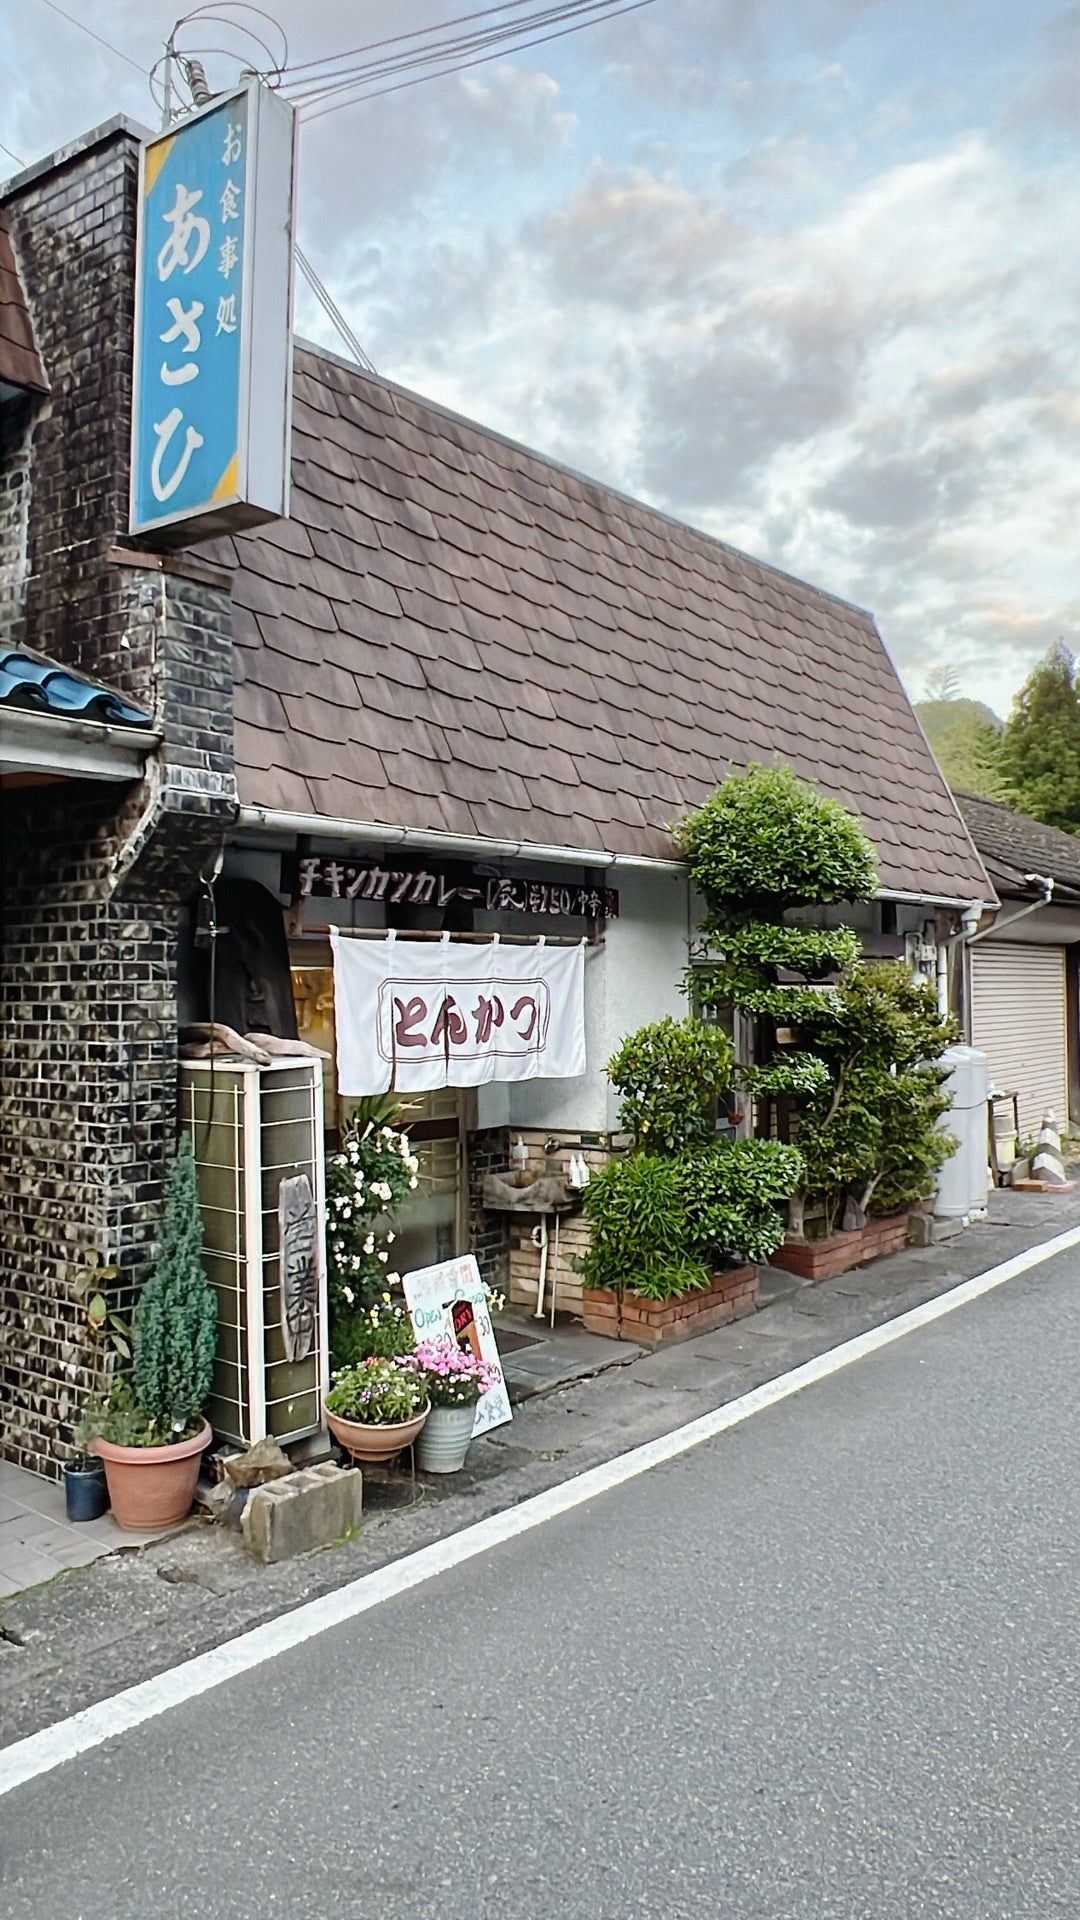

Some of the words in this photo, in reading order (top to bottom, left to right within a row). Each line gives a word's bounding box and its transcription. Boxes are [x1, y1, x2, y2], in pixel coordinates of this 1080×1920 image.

[215, 122, 243, 338] お食事処
[151, 183, 211, 502] あさひ
[393, 994, 538, 1048] とんかつ
